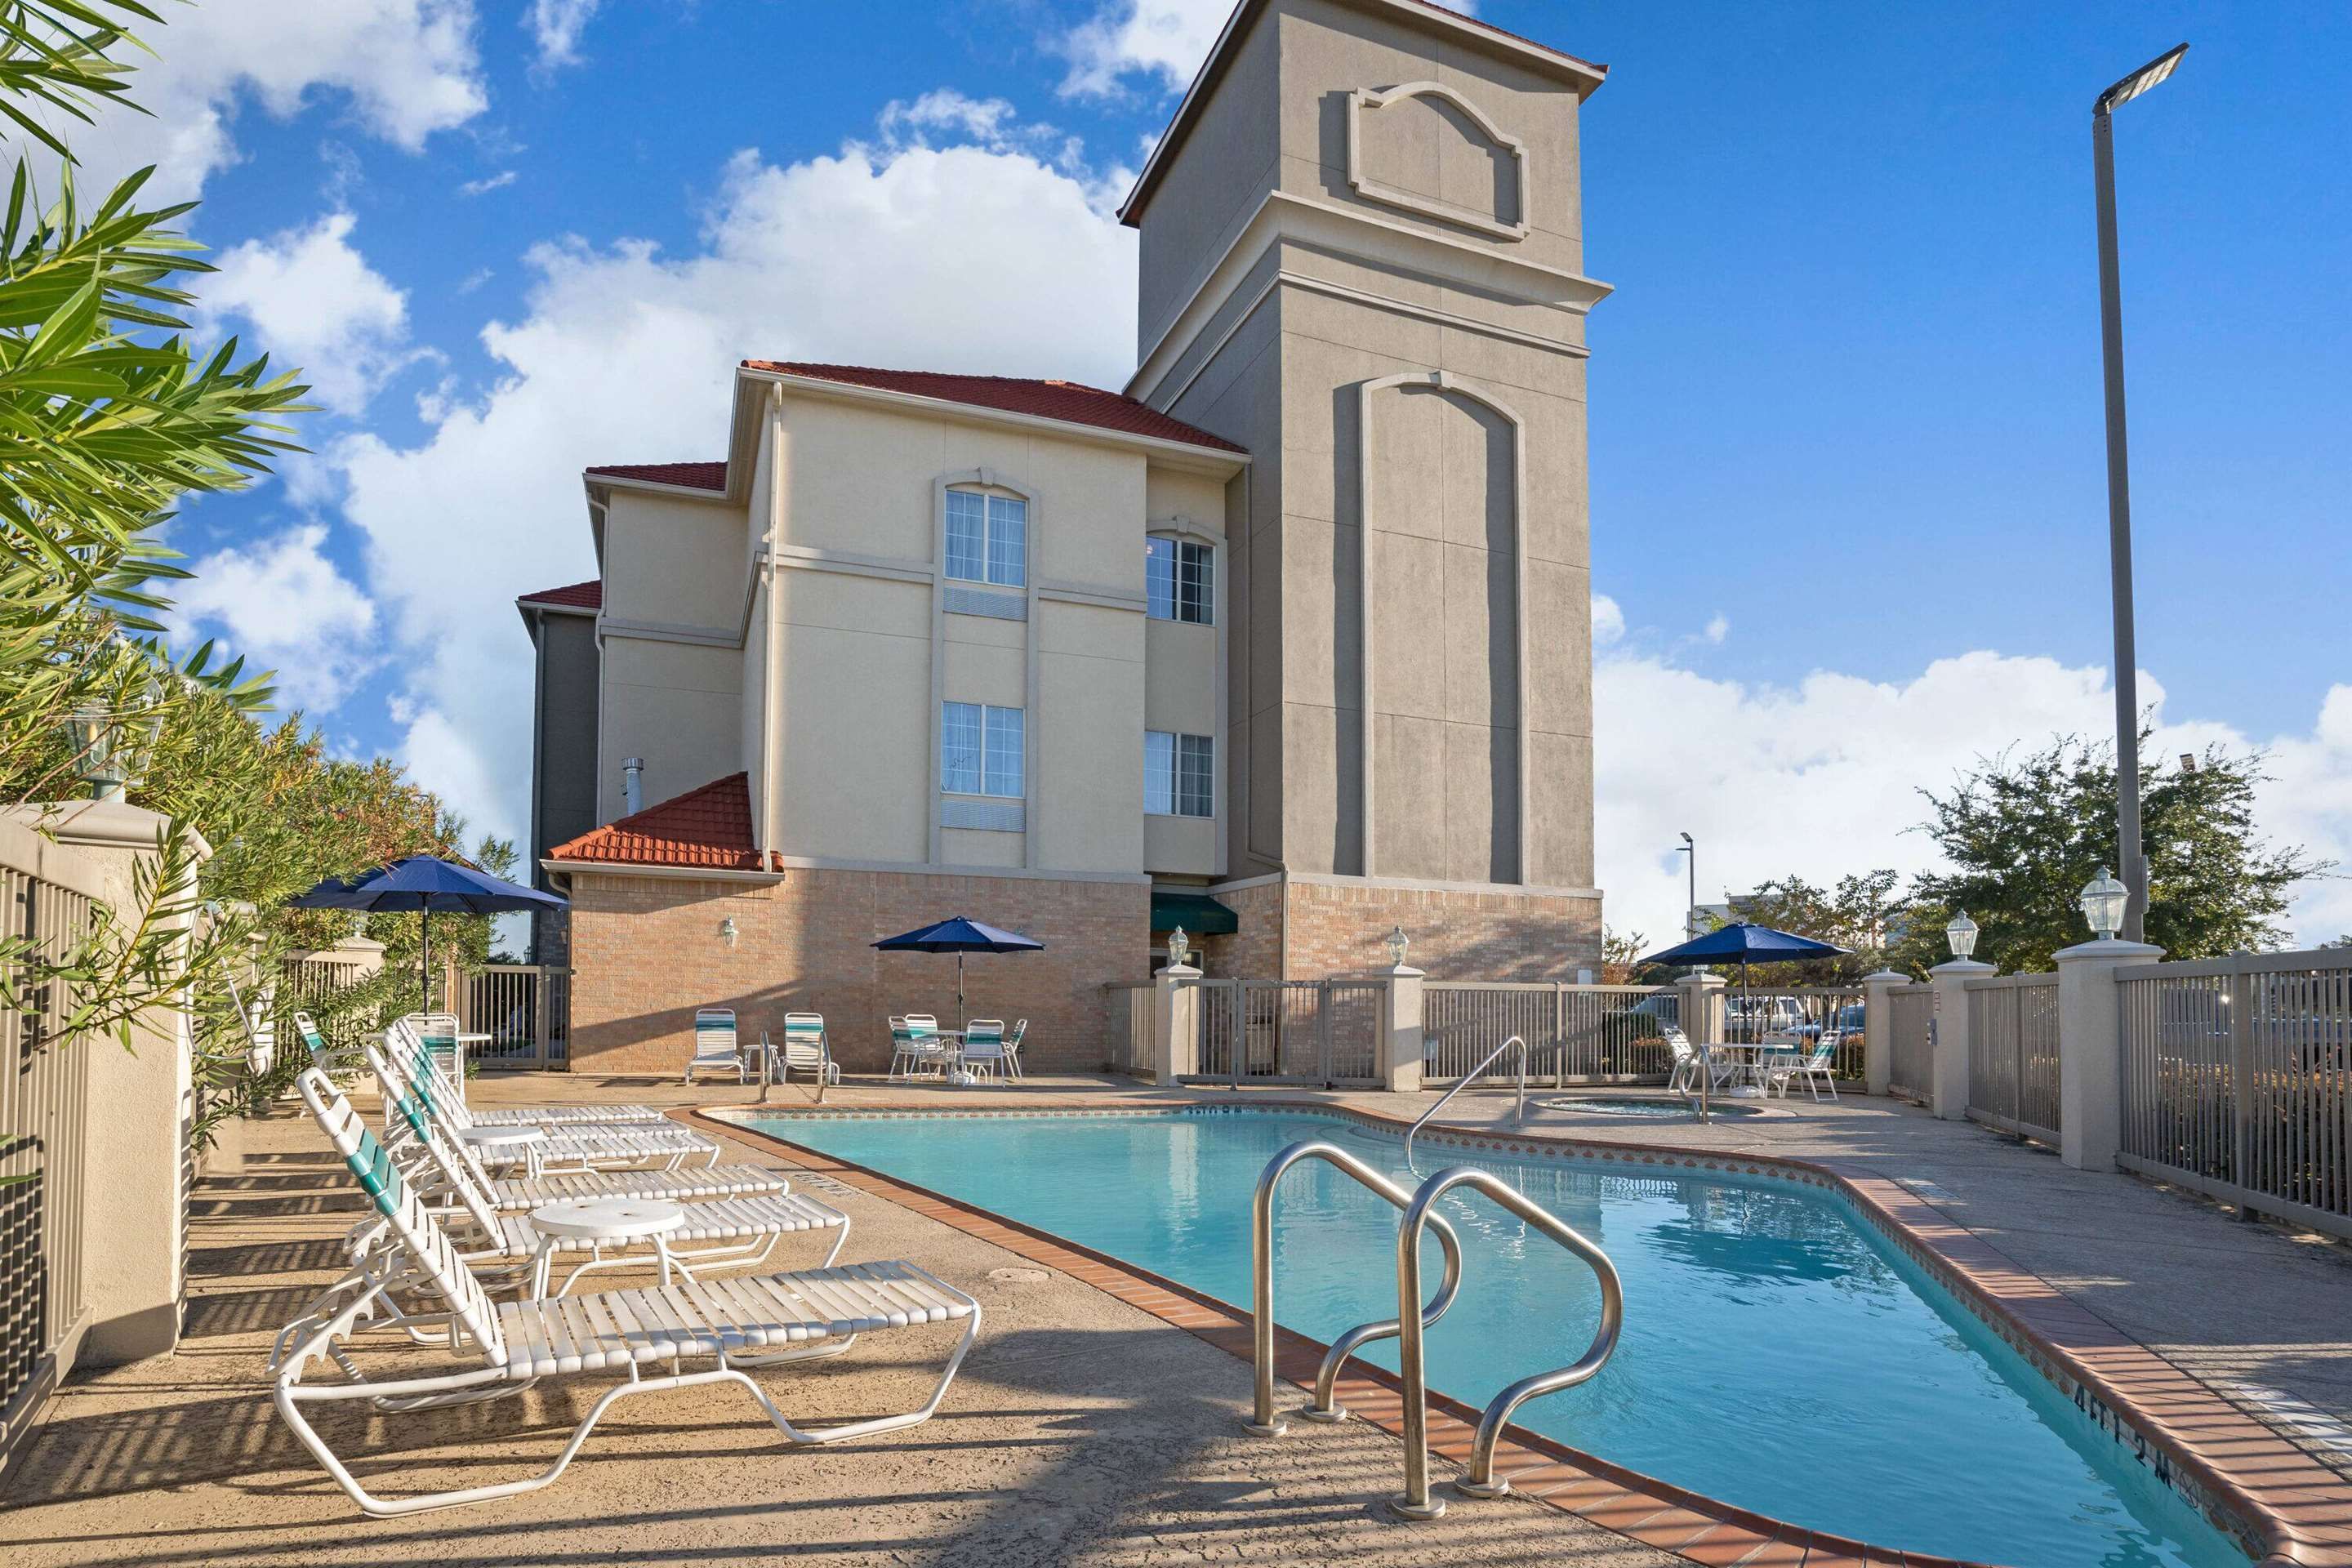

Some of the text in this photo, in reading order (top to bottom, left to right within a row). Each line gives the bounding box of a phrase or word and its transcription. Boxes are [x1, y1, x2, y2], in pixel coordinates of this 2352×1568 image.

[2074, 1383, 2085, 1413] 4
[2090, 1392, 2107, 1431] FT
[2134, 1429, 2147, 1468] 2
[2155, 1449, 2173, 1491] M
